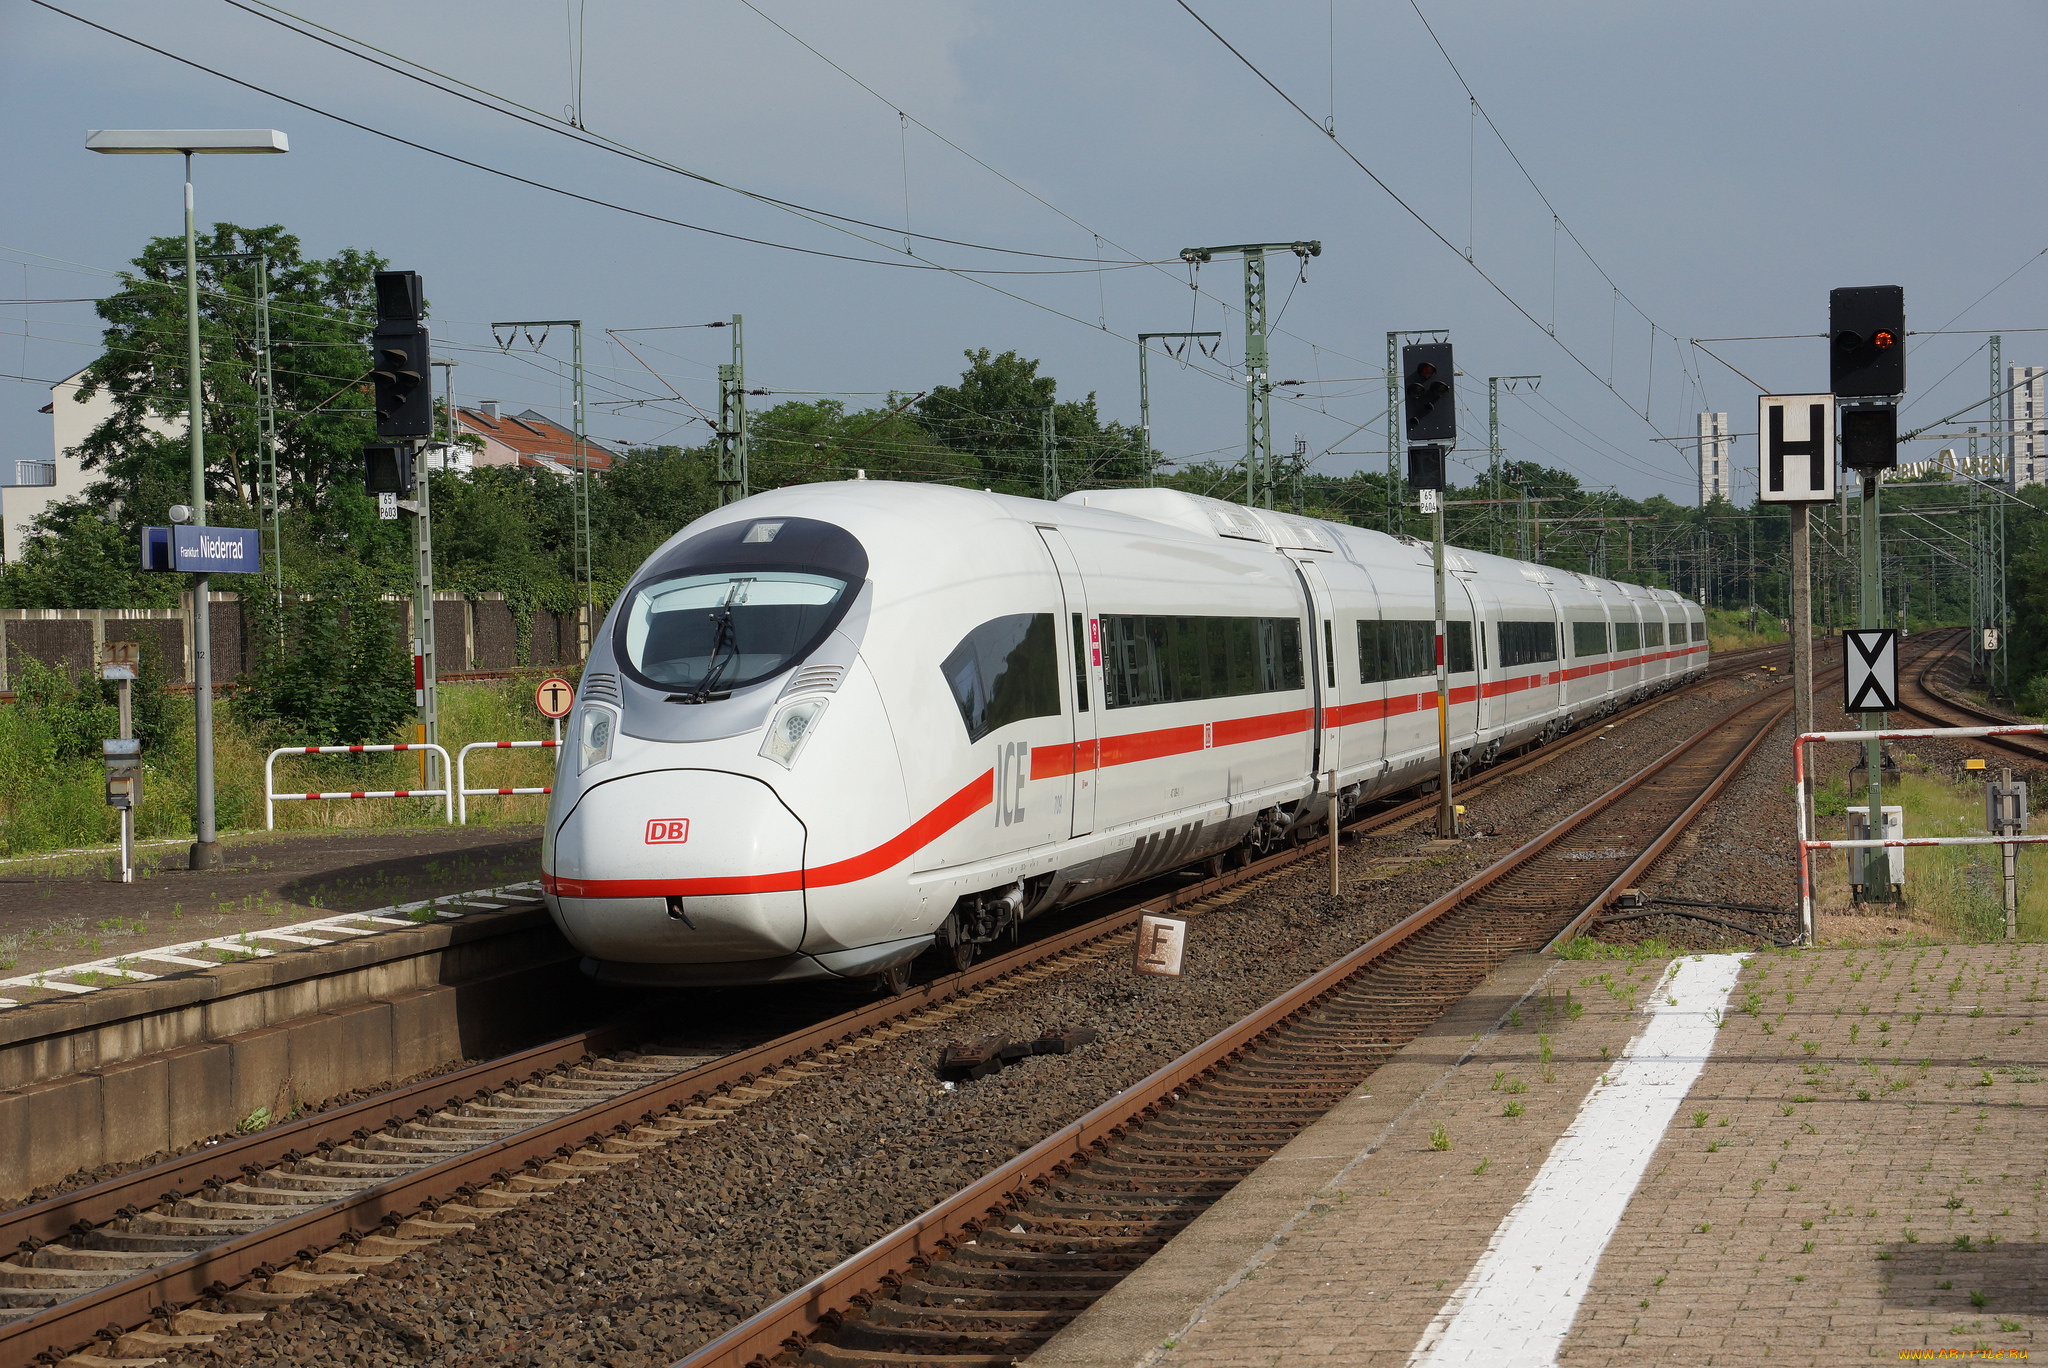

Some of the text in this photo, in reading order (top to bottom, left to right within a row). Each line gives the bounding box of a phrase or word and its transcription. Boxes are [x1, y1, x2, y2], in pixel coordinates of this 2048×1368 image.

[1768, 404, 1825, 492] H
[383, 495, 393, 505] 65
[1424, 491, 1433, 500] 65
[1420, 502, 1436, 512] P604
[380, 507, 397, 518] P603
[180, 535, 244, 560] Frankfurt Niederrad
[1987, 630, 1994, 638] 4
[1987, 640, 1994, 648] 6
[994, 741, 1028, 828] ICE
[650, 822, 684, 841] DB
